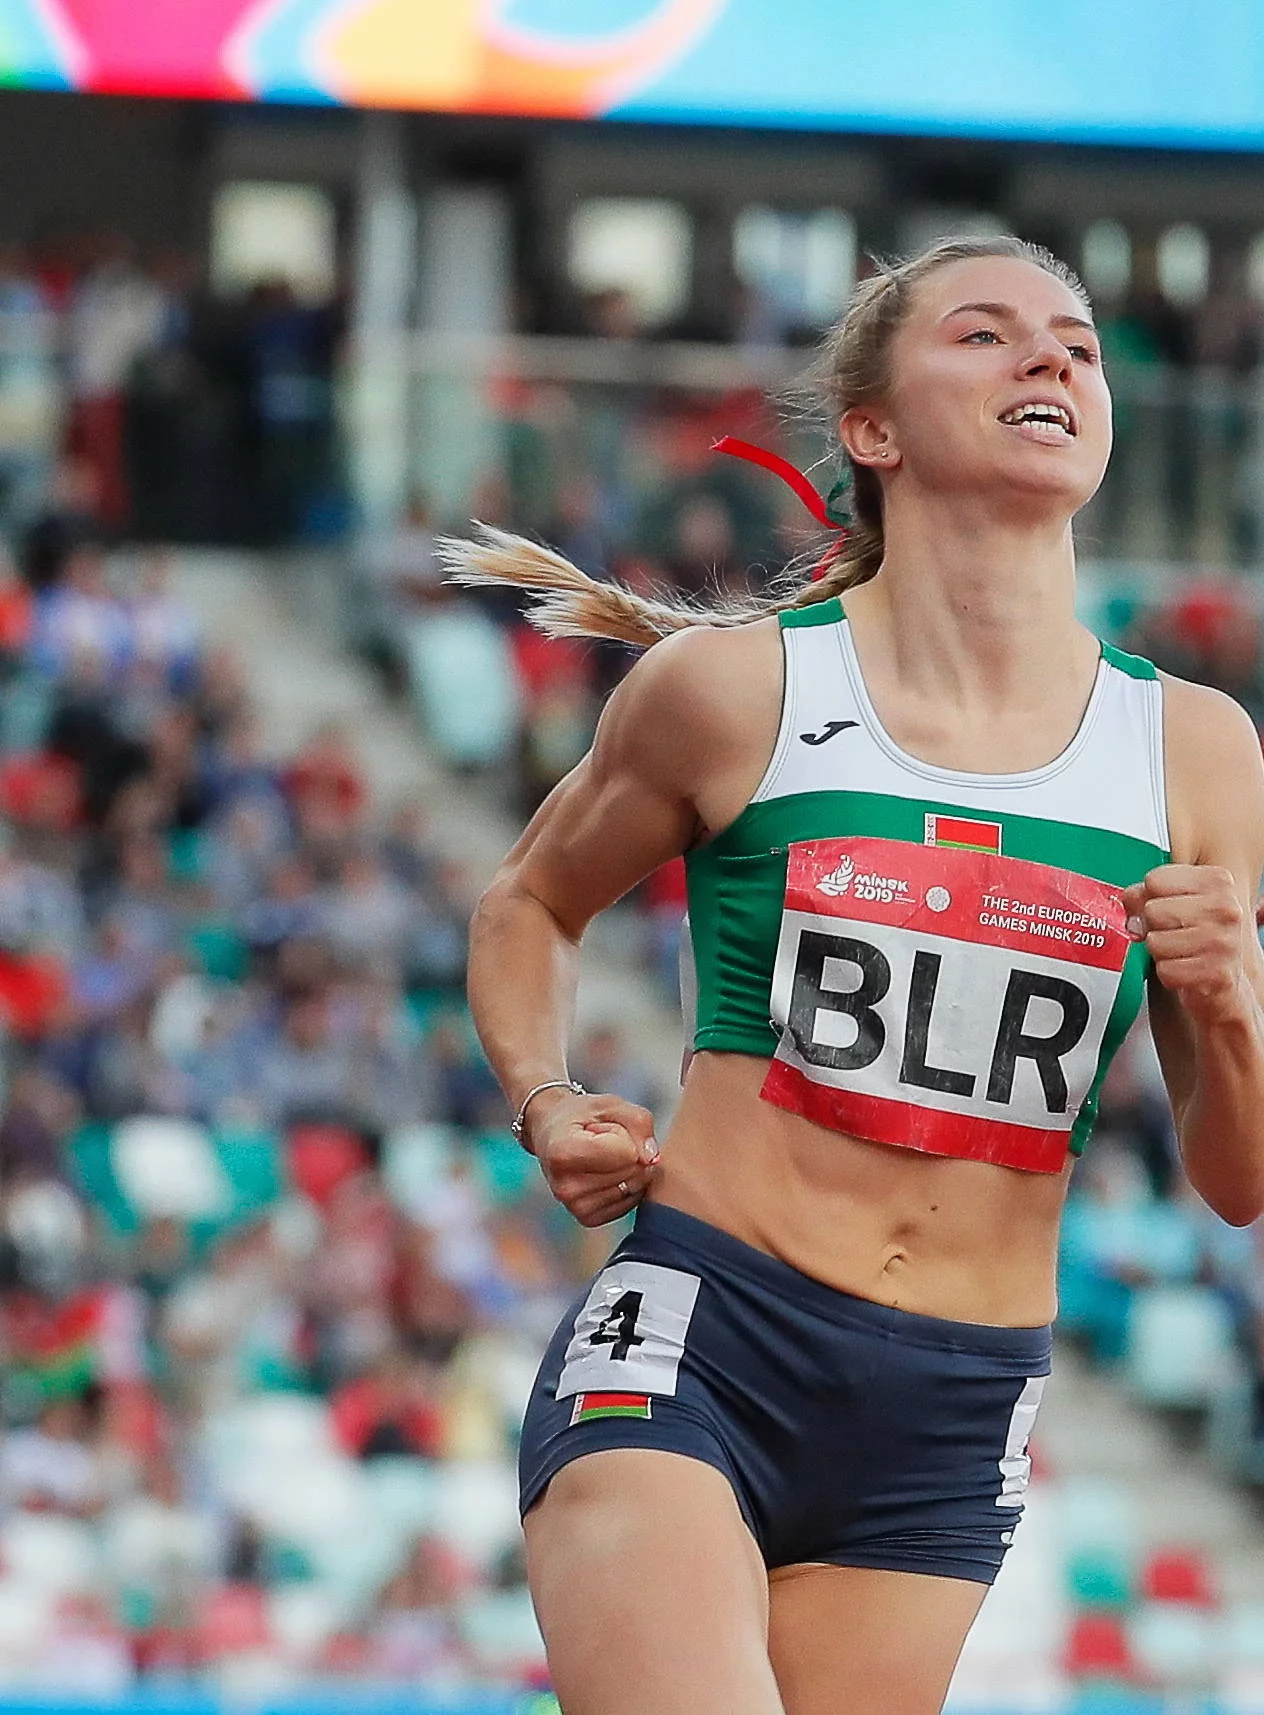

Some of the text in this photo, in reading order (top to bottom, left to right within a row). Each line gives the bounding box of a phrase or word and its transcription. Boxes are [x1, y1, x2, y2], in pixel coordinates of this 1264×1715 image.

[854, 884, 894, 903] 2019
[979, 912, 1105, 948] GAMES MINSK 2019
[982, 894, 1108, 931] THE 2nd EUROPEAN
[787, 929, 1090, 1113] BLR
[589, 1290, 646, 1361] 4
